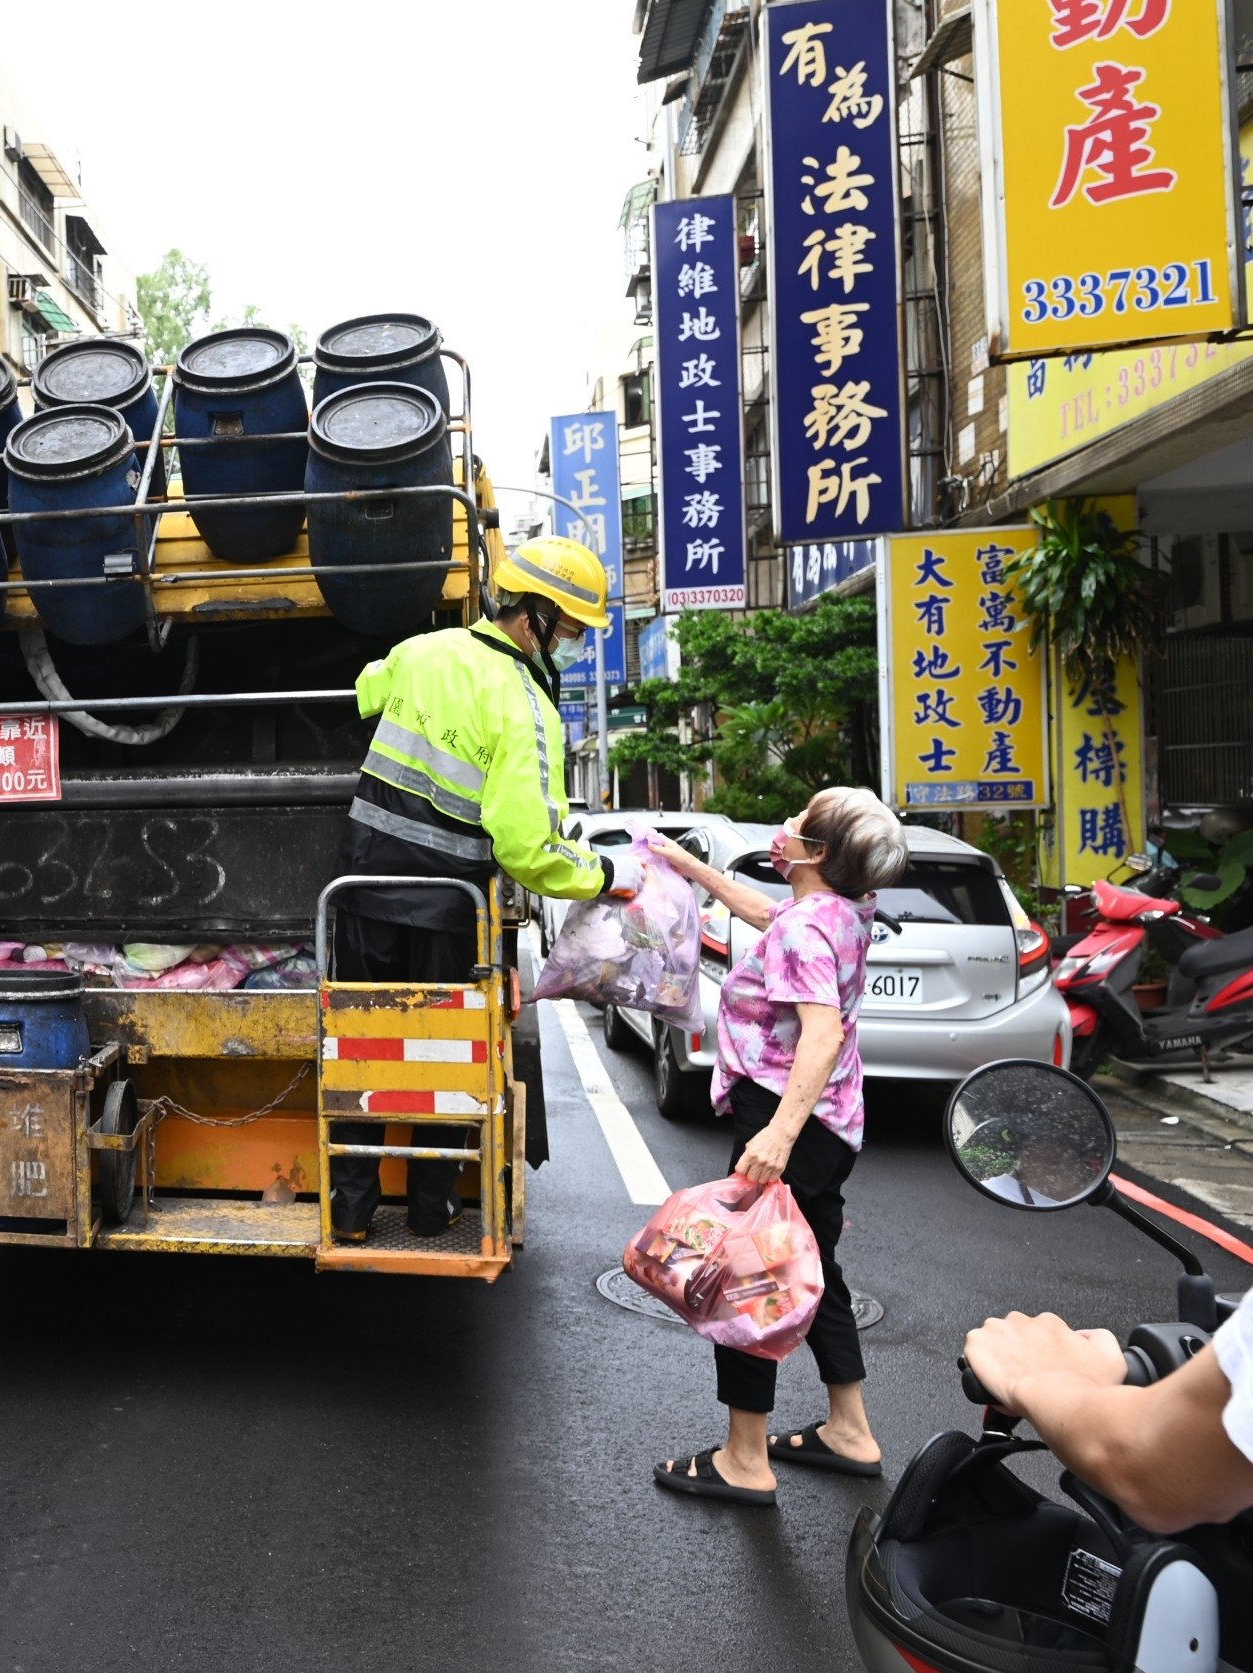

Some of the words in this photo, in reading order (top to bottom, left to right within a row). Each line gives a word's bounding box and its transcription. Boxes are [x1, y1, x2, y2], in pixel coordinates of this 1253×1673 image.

[779, 22, 888, 525] 有為法律事務所
[1023, 259, 1217, 323] 3337321
[674, 213, 725, 575] 律維地政士事務所
[668, 588, 744, 605] (03)3370320
[913, 549, 961, 772] 大有地政士
[387, 691, 490, 765] 園市政府
[1158, 1036, 1202, 1050] YAMAHA
[9, 1103, 47, 1198] 堆肥
